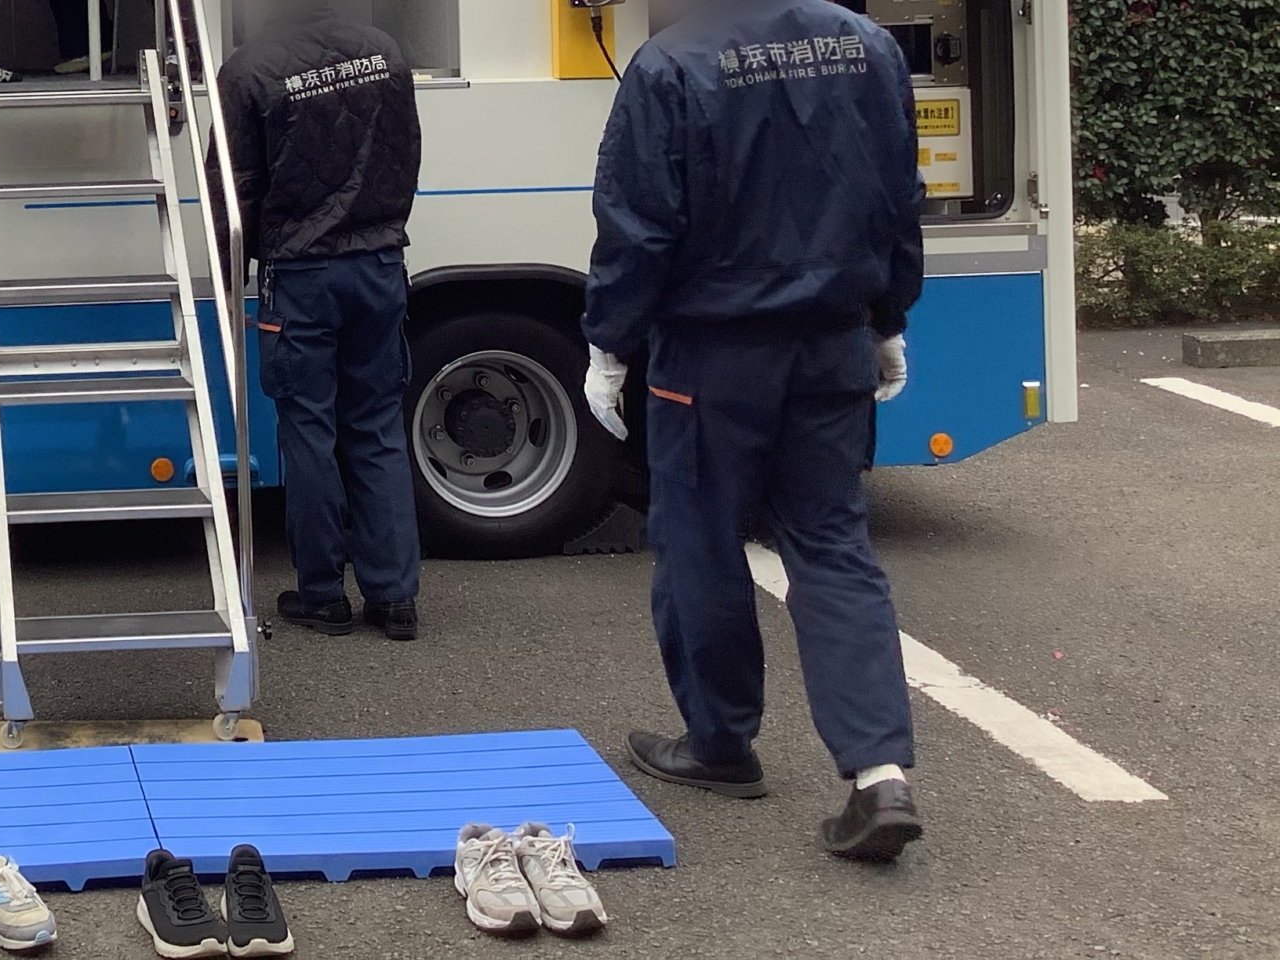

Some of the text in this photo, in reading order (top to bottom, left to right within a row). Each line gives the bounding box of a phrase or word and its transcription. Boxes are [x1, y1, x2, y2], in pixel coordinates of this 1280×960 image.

[718, 35, 866, 74] 横浜市消防局
[820, 63, 867, 76] BURAU
[285, 54, 387, 93] 横浜市消防局
[289, 72, 390, 102] YOKOHAMA FIRE BUREAU
